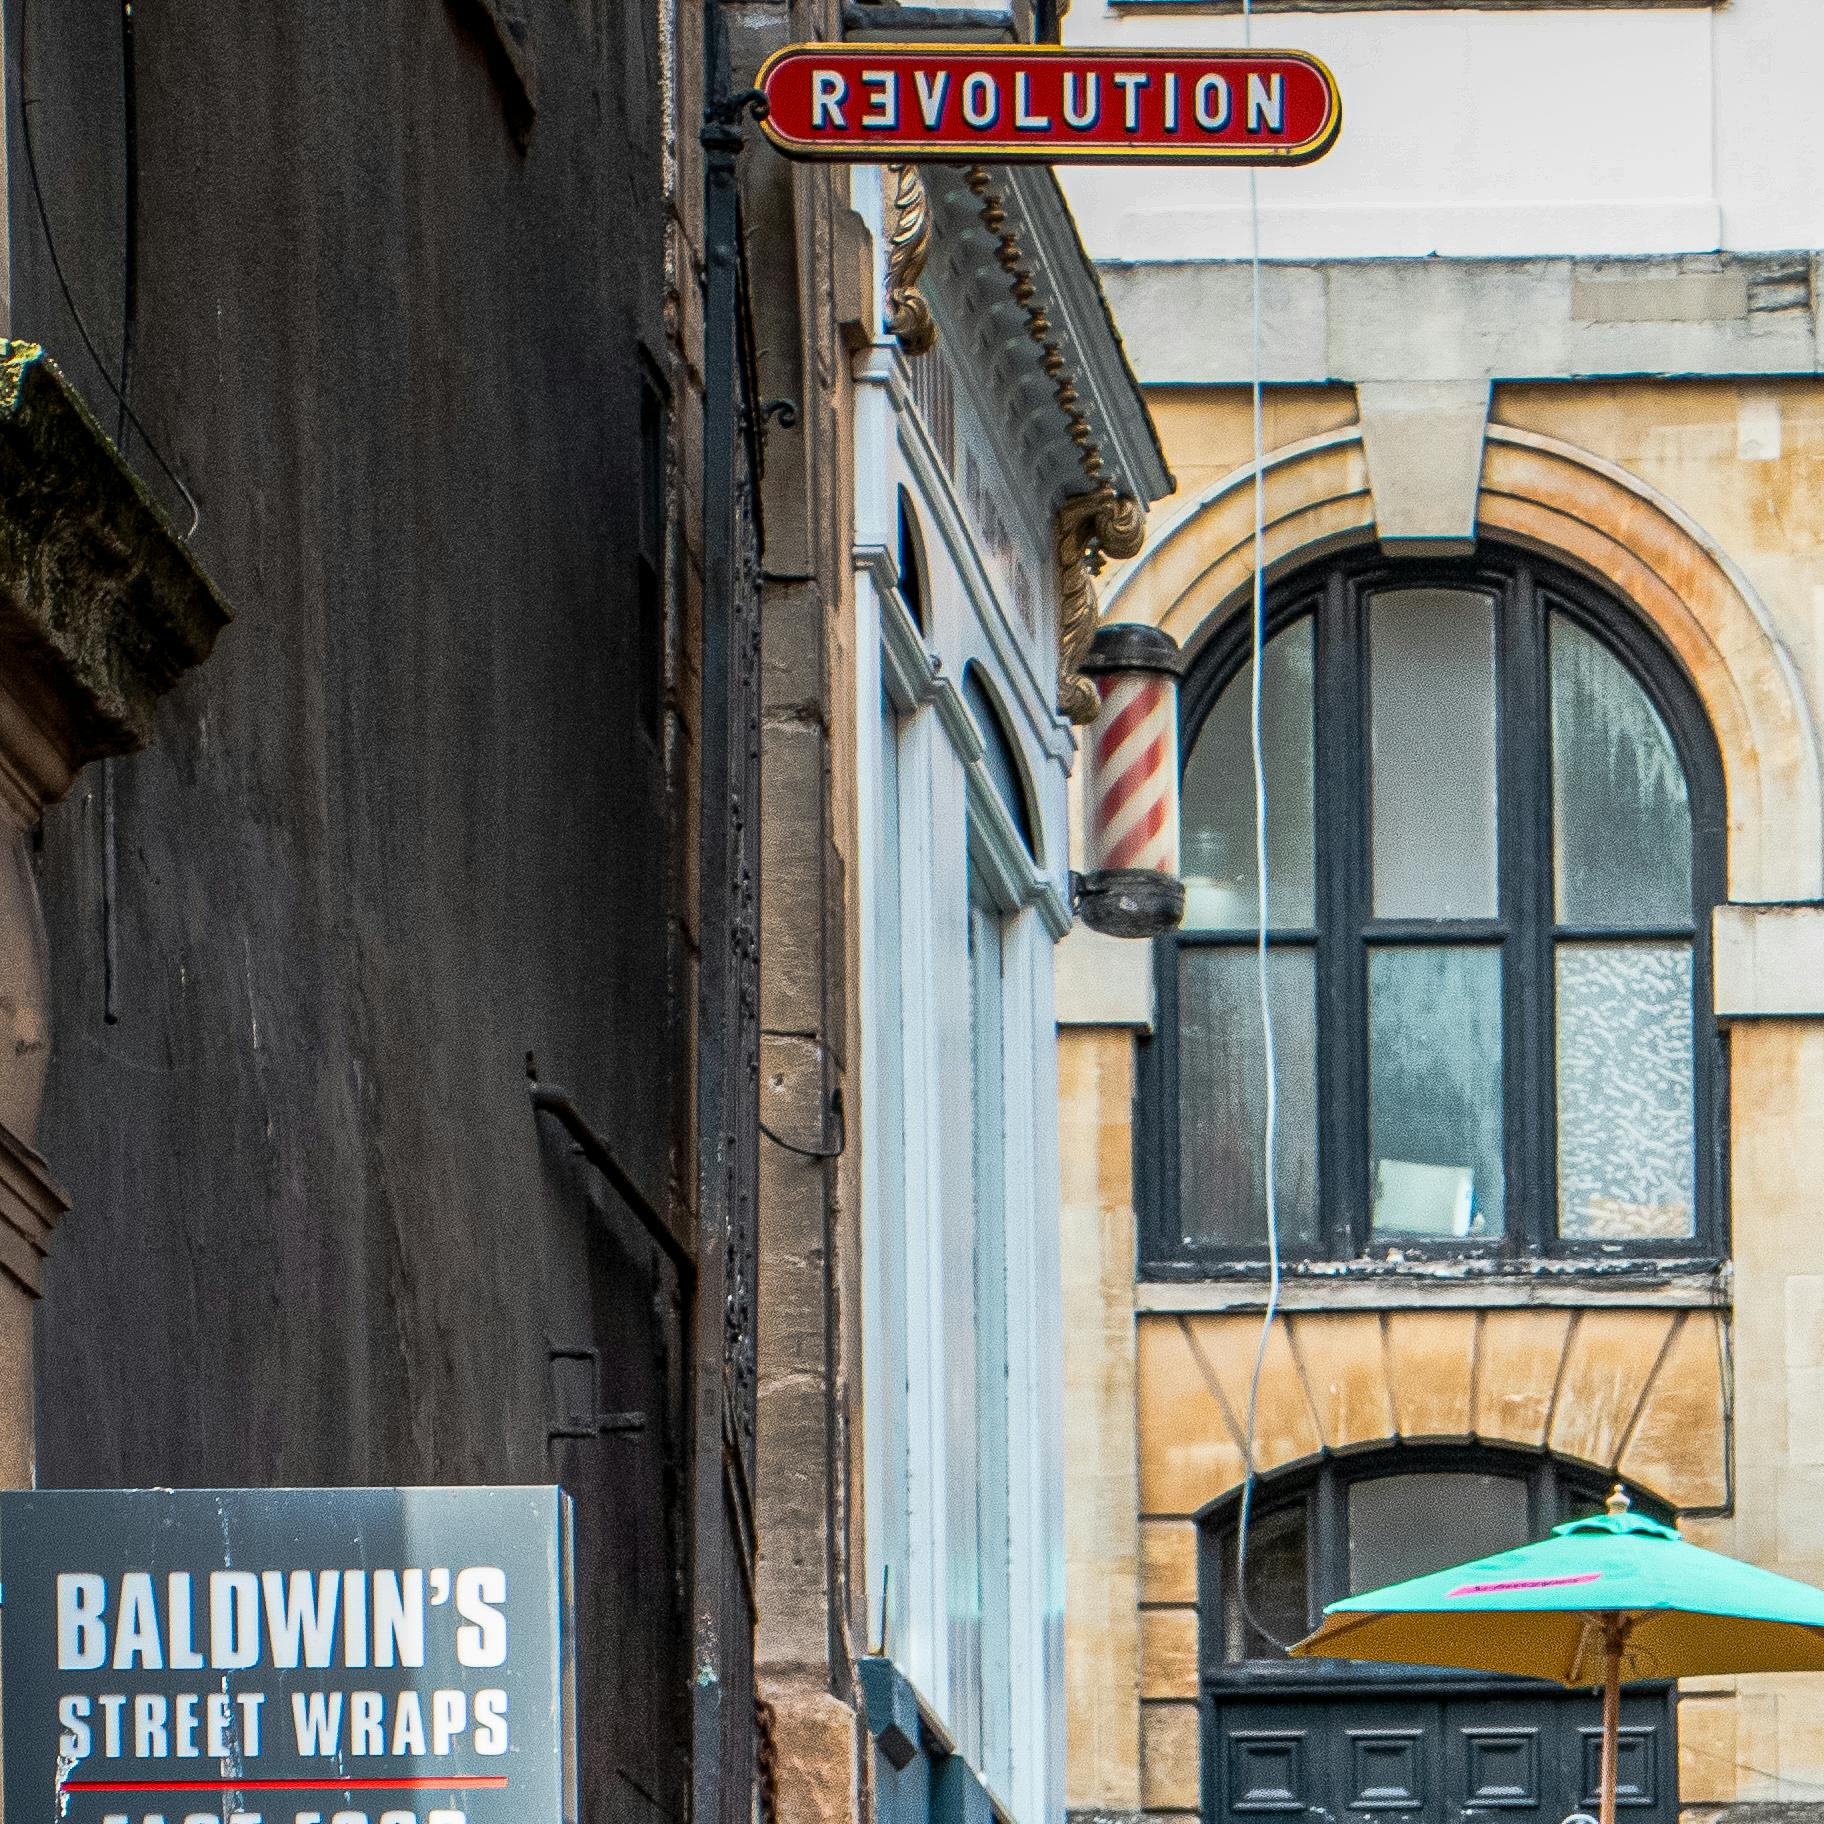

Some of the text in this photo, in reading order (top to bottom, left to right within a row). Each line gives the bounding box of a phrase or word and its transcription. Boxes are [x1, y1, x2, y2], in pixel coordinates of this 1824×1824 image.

[56, 1566, 508, 1670] BALDWIN'S
[58, 1688, 508, 1758] STREET WRAPS
